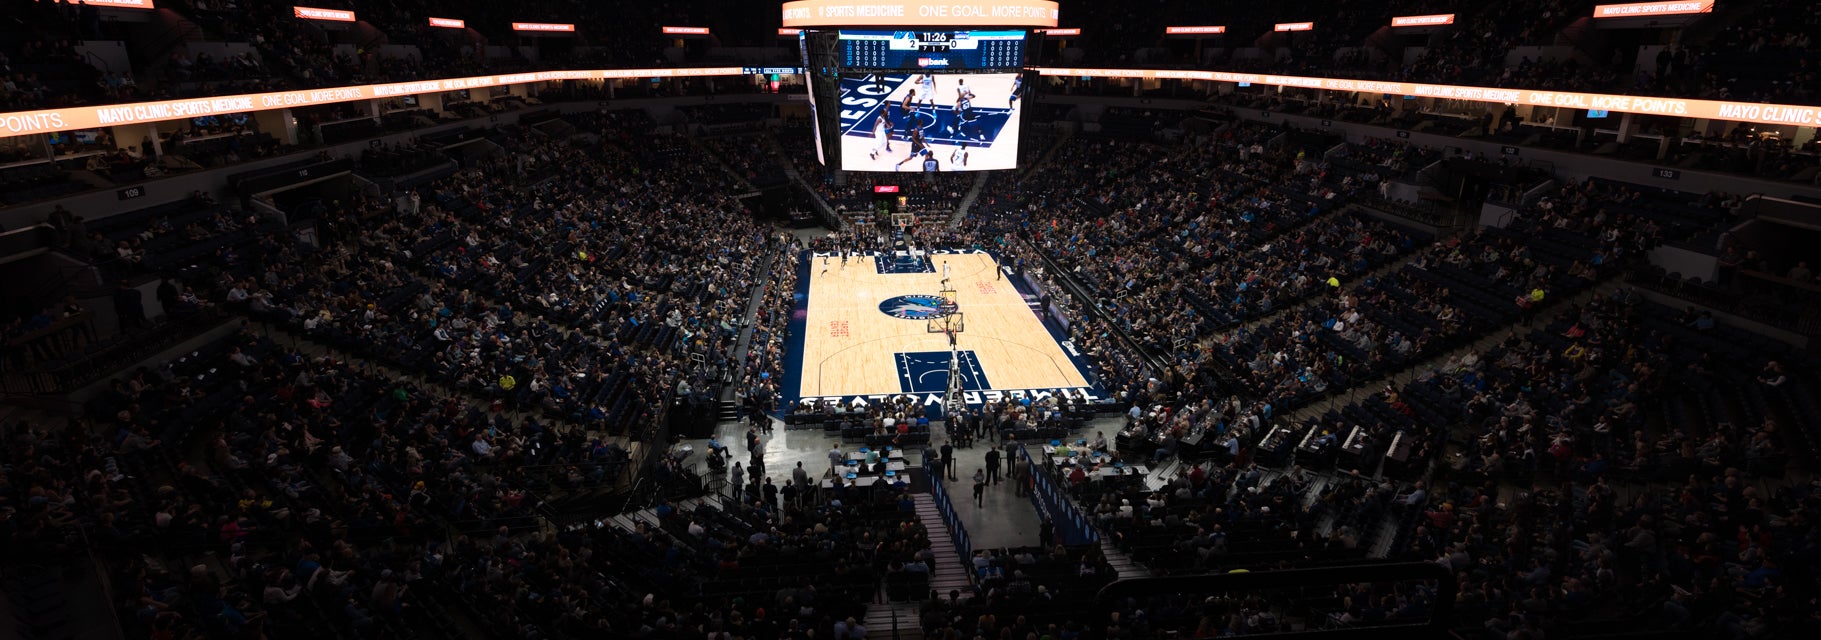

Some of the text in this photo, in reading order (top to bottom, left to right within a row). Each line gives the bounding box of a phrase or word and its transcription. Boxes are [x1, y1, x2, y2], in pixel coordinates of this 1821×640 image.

[826, 6, 854, 17] SPORTS
[856, 5, 904, 16] MEDICINE
[919, 5, 948, 17] ONE
[951, 5, 988, 17] GOAL.
[992, 6, 1020, 18] MORE
[1603, 2, 1700, 14] MAYO CLINIC SPORTS MEDICINE
[923, 32, 946, 42] 11:26
[910, 40, 915, 48] 2
[951, 40, 956, 48] 0
[1326, 80, 1338, 89] ONE
[1357, 81, 1376, 91] MORE
[262, 88, 362, 108] ONE GOAL. MORE POINTS.
[1416, 86, 1520, 101] MAYO CLINIC SPORTS MEDICINE
[1529, 92, 1688, 114] ONE GOAL. MORE POINTS.
[97, 97, 254, 124] MAYO CLINIC SPORTS MEDICINE
[1718, 104, 1760, 120] MAYO
[1762, 106, 1812, 123] CLINIC
[0, 112, 68, 132] POINTS.
[124, 188, 139, 197] 109
